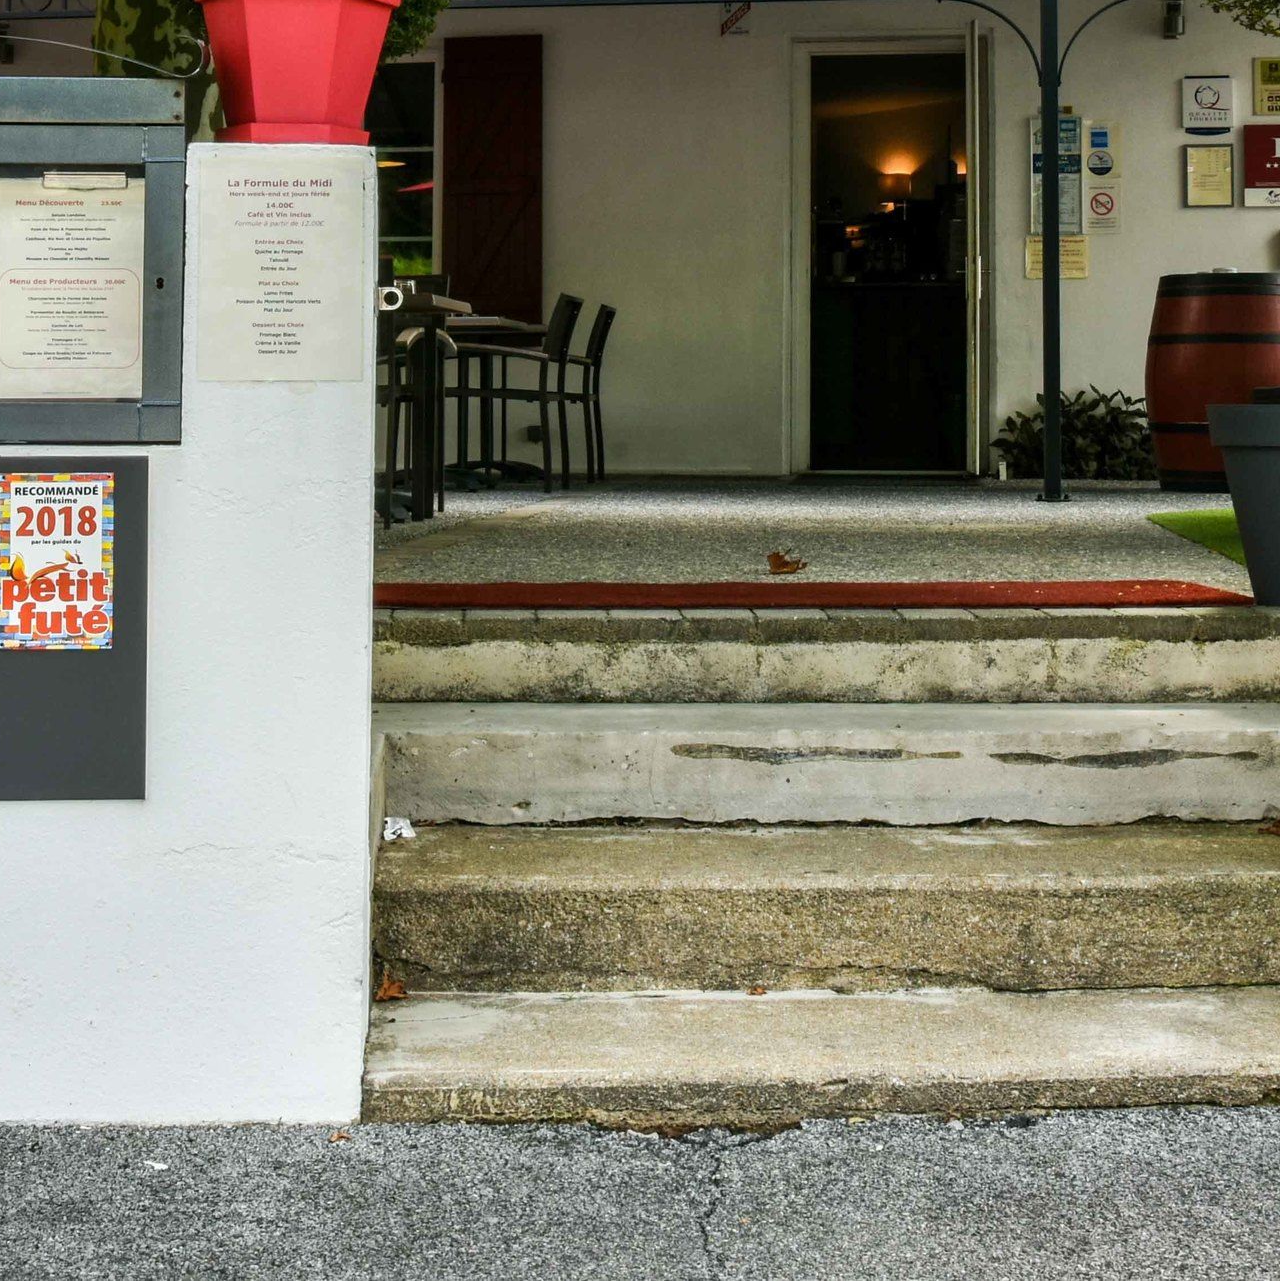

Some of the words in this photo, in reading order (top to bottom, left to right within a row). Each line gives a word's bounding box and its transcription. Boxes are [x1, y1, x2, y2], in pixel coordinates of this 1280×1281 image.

[228, 179, 240, 187] La
[244, 179, 289, 187] Formule
[292, 179, 306, 187] du
[310, 179, 332, 187] Midi
[15, 486, 99, 496] RECOMMANDÉ
[16, 506, 97, 537] 2018
[2, 568, 109, 610] petit
[18, 603, 108, 636] futé
